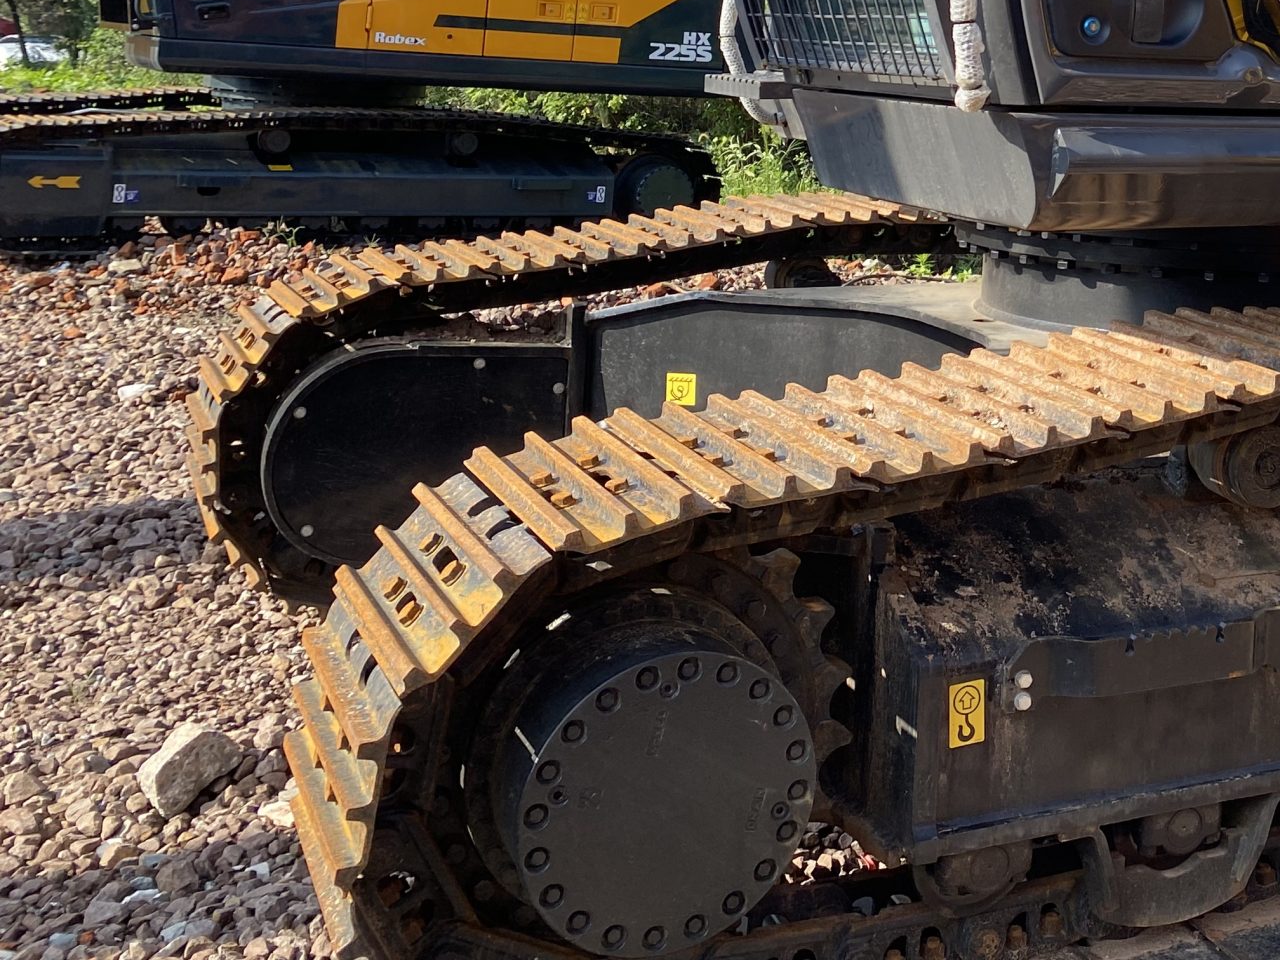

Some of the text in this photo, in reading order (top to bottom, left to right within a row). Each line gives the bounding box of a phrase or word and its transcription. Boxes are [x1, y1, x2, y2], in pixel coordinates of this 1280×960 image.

[374, 31, 427, 46] Robex
[682, 31, 712, 46] HX
[648, 42, 713, 62] 225S
